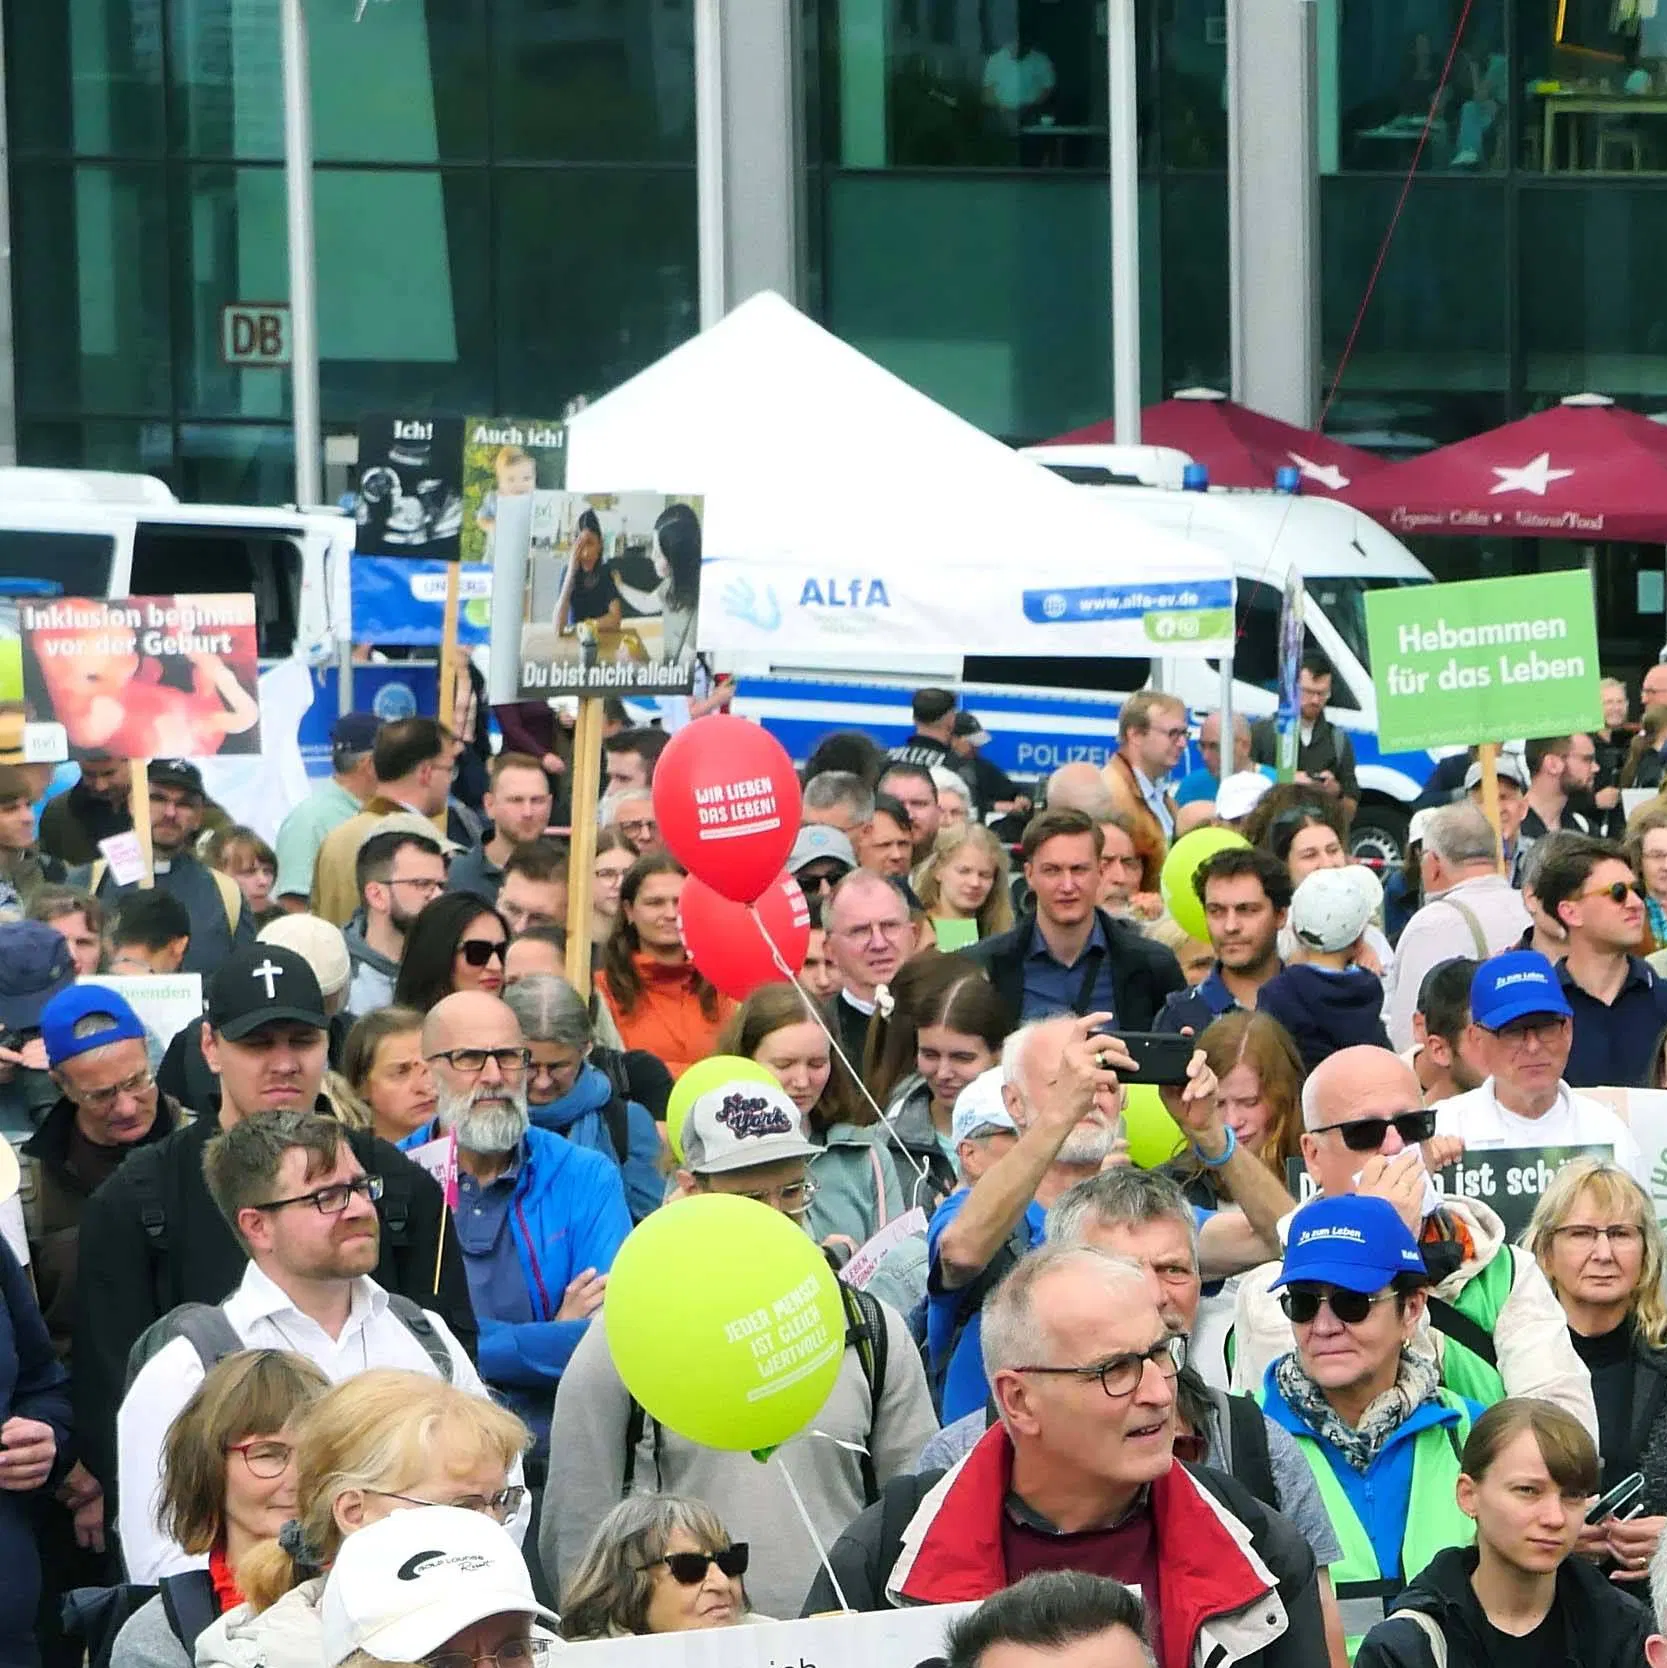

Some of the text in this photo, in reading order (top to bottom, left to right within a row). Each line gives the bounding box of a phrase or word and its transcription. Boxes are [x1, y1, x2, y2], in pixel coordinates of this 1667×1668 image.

[232, 314, 283, 355] DB
[393, 420, 434, 440] Ich!
[473, 426, 563, 448] Auch ich!
[799, 577, 891, 609] ALfA
[1079, 591, 1199, 612] www.alfa-ev.de
[24, 603, 142, 629] Inklusion
[45, 631, 233, 657] vor der Geburt
[1397, 616, 1567, 654] Hebammen
[522, 661, 690, 687] Du bist nicht allein!
[1386, 650, 1585, 695] für das Leben
[695, 776, 773, 805] WIR LIEBEN
[698, 799, 777, 826] DAS LEBEN!
[1454, 1159, 1499, 1198] ist
[1331, 1226, 1362, 1238] Leben
[723, 1305, 772, 1344] JEDER
[771, 1272, 821, 1320] MENSCH
[749, 1304, 822, 1359] IST GLEICH
